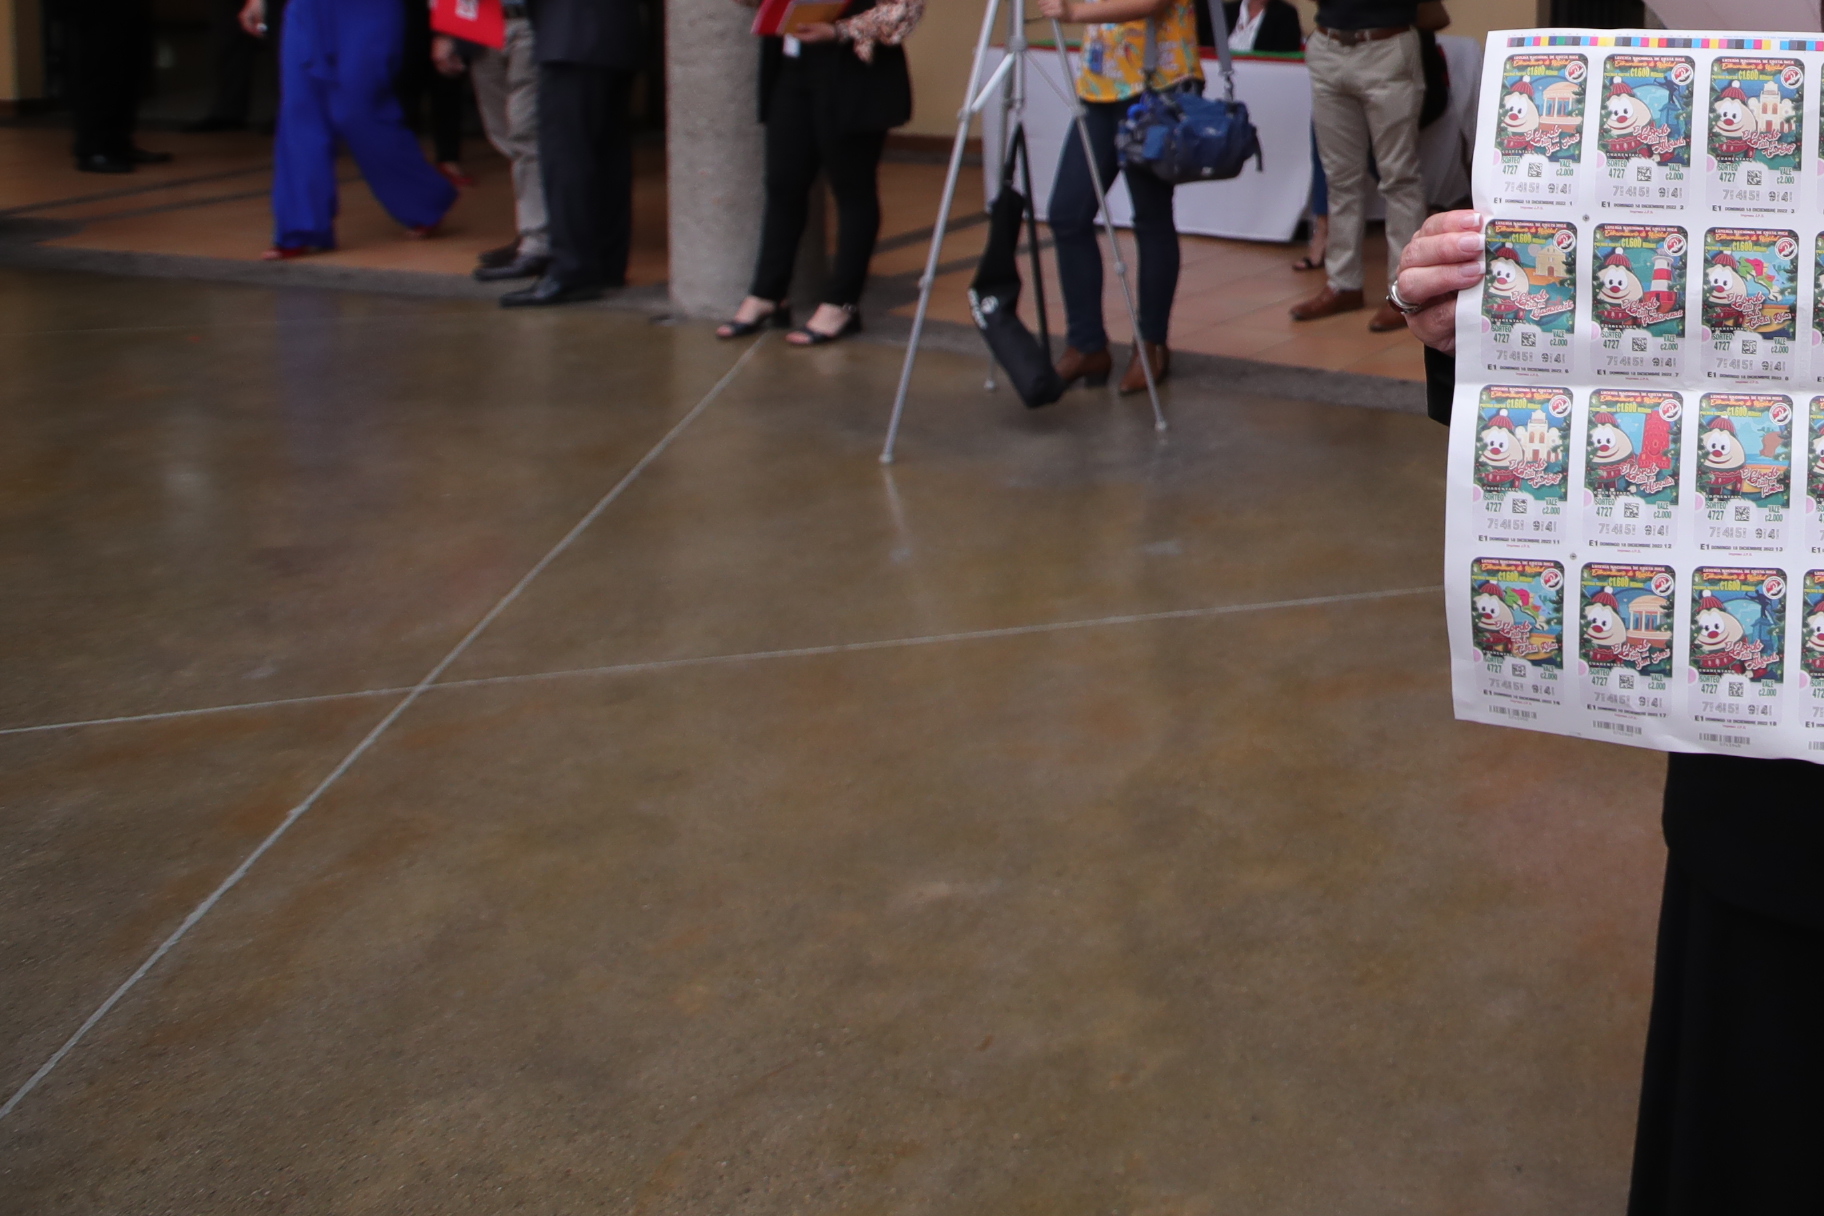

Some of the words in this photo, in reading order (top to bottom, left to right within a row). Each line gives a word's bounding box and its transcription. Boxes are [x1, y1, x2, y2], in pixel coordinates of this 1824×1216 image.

[1717, 163, 1738, 172] SORTEO
[1719, 172, 1736, 183] 4727
[1811, 546, 1821, 554] E1
